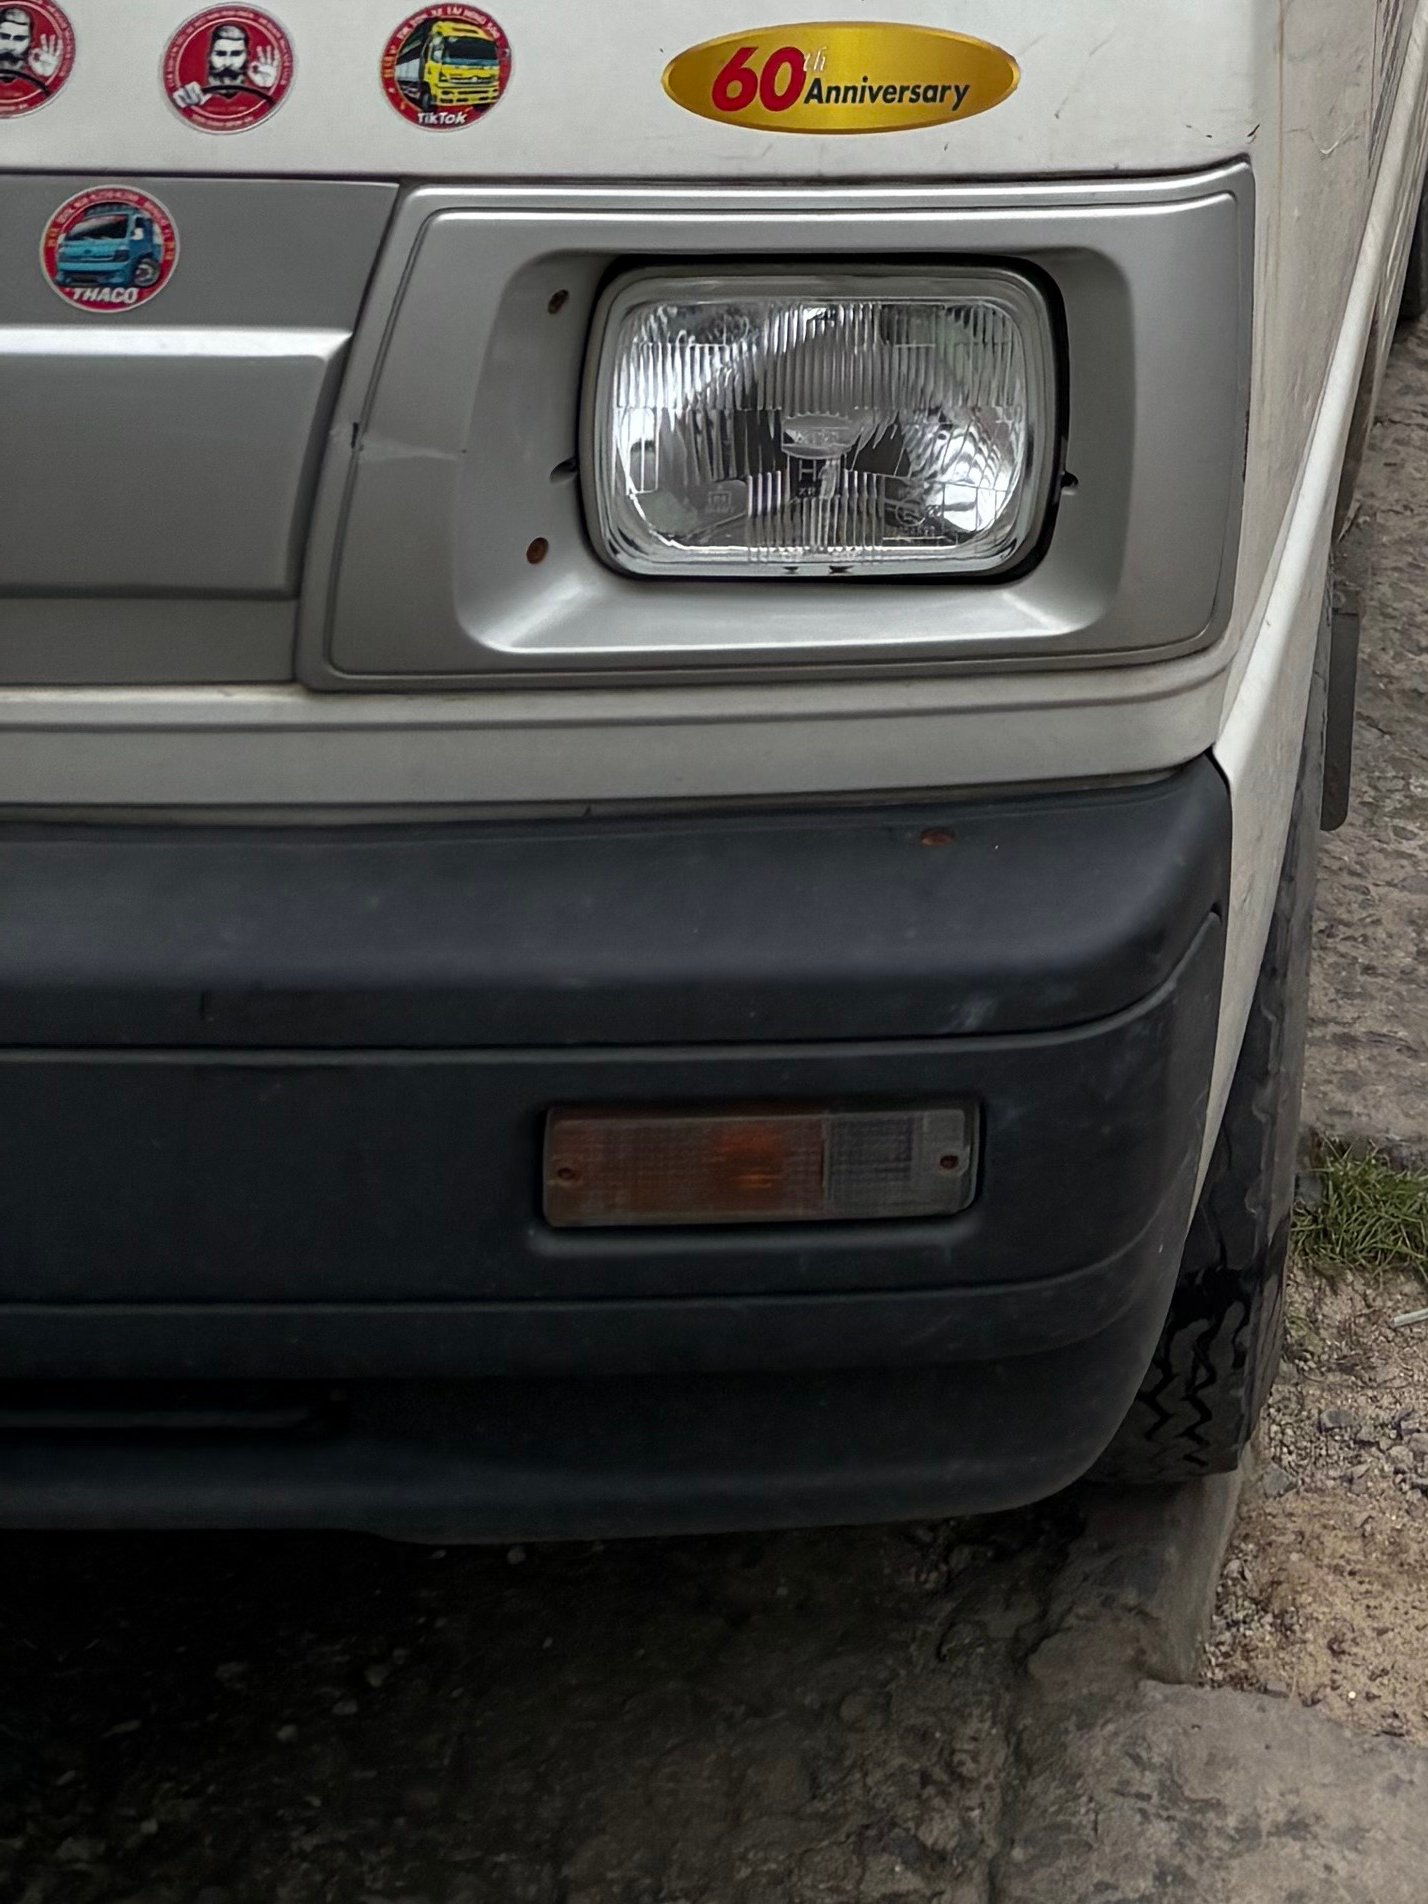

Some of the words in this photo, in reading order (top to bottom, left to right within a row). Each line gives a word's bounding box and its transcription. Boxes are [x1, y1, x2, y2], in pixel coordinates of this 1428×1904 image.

[804, 76, 971, 110] Anniversary
[417, 110, 468, 125] TikTok
[72, 286, 141, 304] THACO
